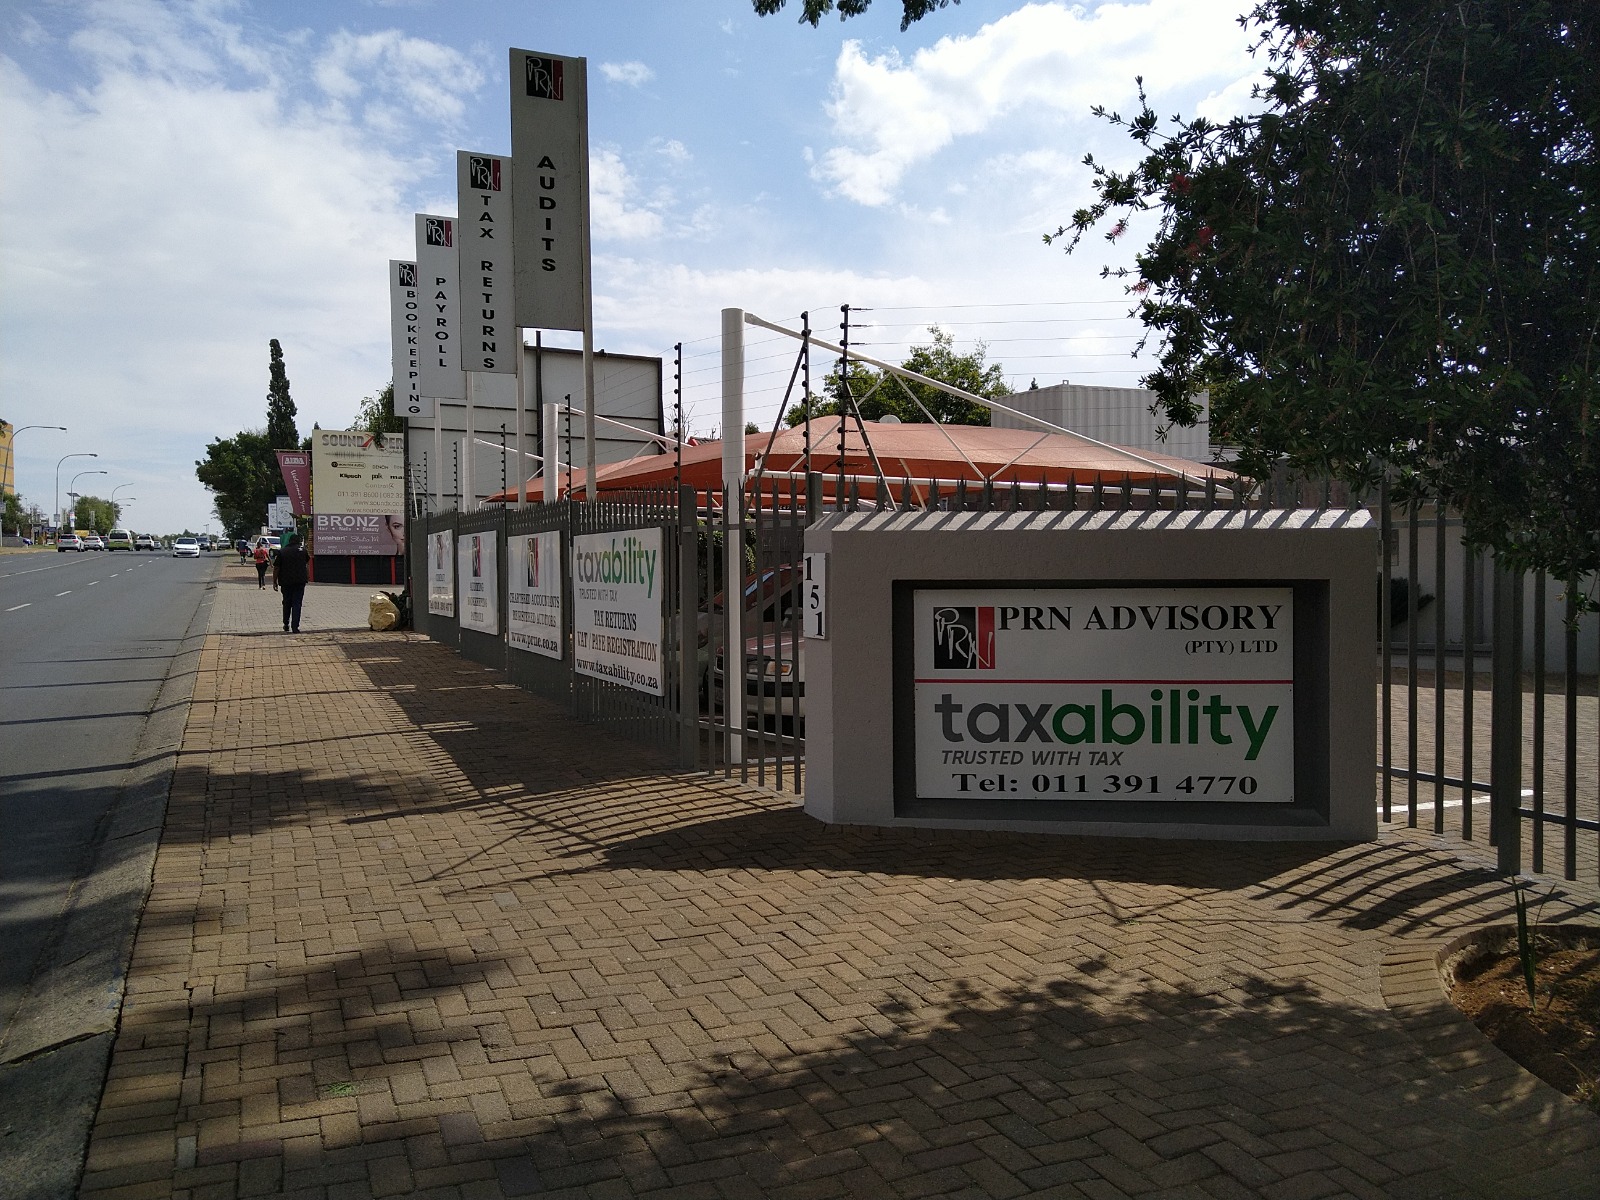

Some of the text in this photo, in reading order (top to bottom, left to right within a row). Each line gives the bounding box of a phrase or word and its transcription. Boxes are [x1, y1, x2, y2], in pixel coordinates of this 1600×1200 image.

[527, 57, 562, 99] PRN
[470, 157, 500, 191] PRN
[537, 155, 557, 272] AUDITS
[426, 219, 452, 247] PRN
[479, 195, 496, 369] TAX RETURNS
[434, 277, 449, 367] PAYROLL
[405, 290, 421, 414] BOOKKEEPING
[317, 515, 380, 527] BRONZ
[576, 536, 657, 599] taxability
[594, 610, 637, 631] TAX RETURNS
[998, 605, 1283, 631] PRN ADVISORY
[577, 631, 588, 648] VAT
[592, 633, 606, 652] PAYE
[606, 635, 658, 662] REGISTRATION
[934, 607, 994, 669] PRN
[1184, 639, 1279, 656] (PTY) LTD
[576, 658, 659, 690] www.taxability.co.za
[934, 689, 1279, 761] taxability
[941, 750, 1124, 767] TRUSTED WITH TAX
[951, 773, 1258, 796] Tel: 011 391 4770
